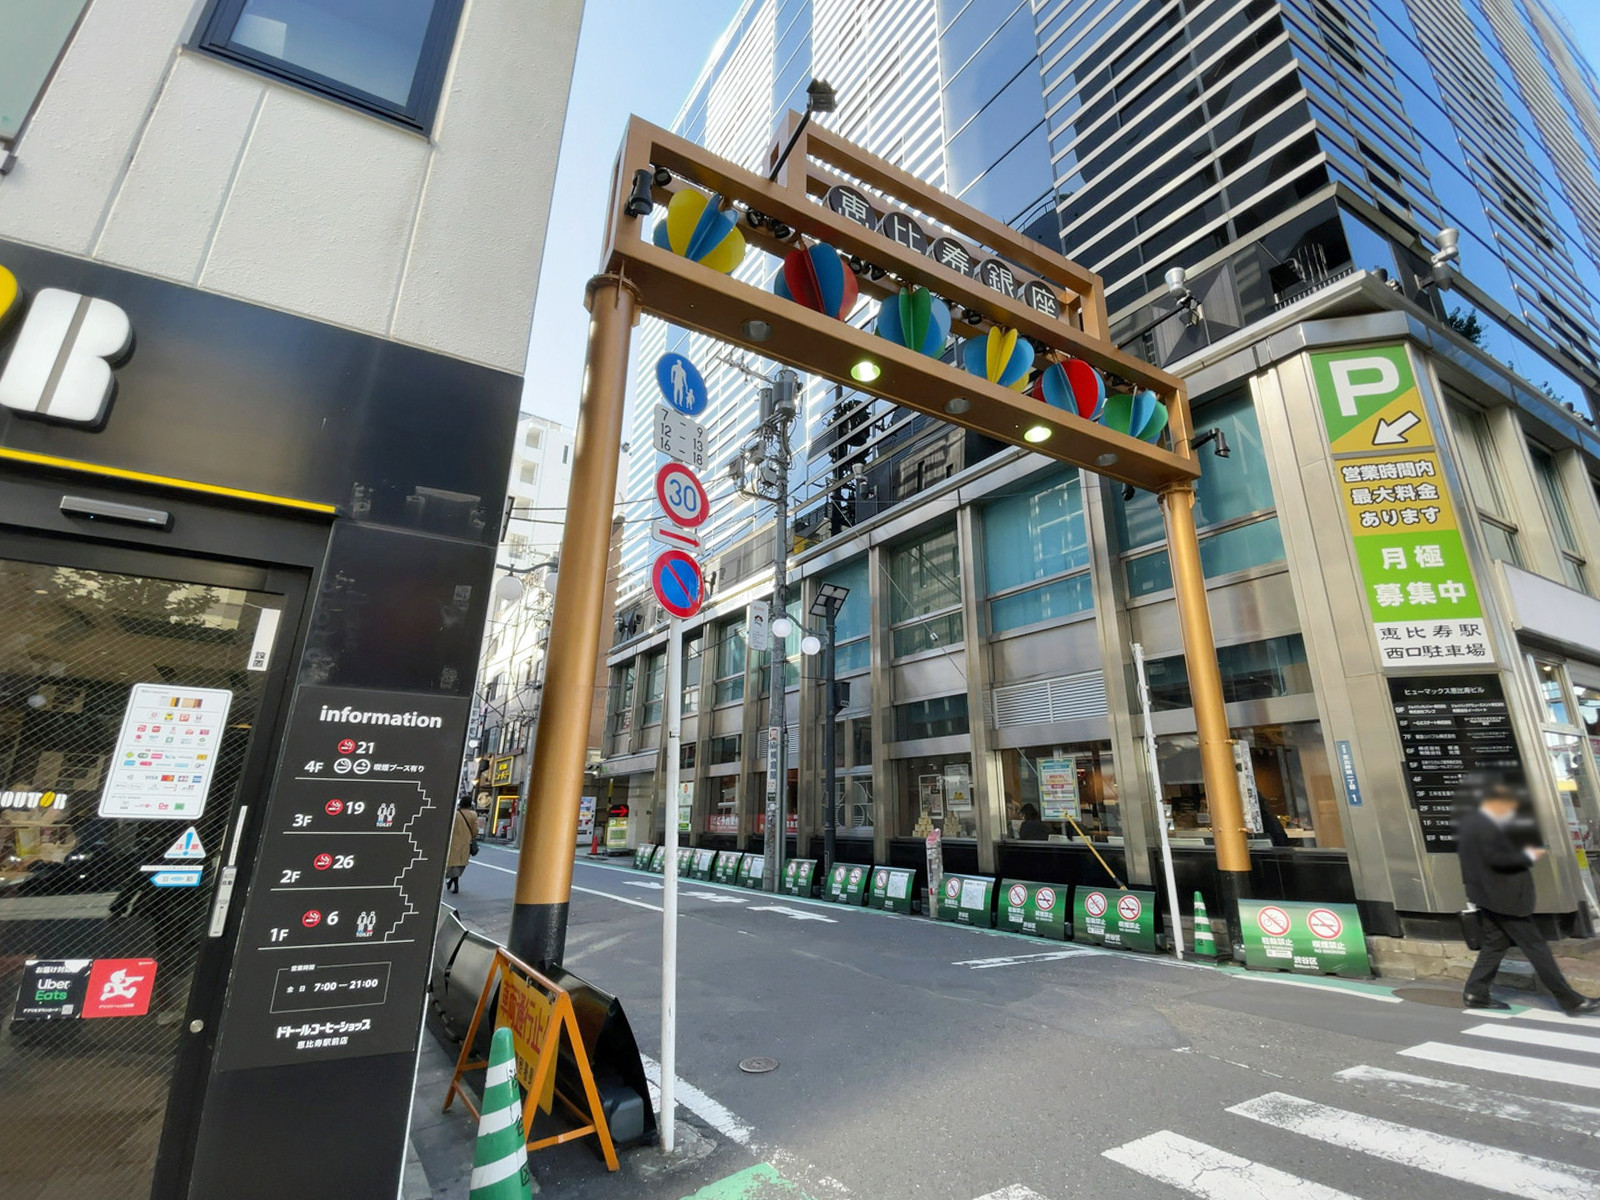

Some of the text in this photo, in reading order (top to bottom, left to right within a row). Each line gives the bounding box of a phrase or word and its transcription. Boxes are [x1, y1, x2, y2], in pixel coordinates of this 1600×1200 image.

[1328, 356, 1399, 416] P
[661, 408, 669, 421] 7
[696, 426, 703, 438] 9
[660, 423, 672, 438] 12
[693, 438, 704, 452] 13
[660, 437, 671, 451] 16
[693, 451, 703, 466] 18
[1341, 459, 1435, 482] 営業時間内
[669, 479, 697, 512] 30
[1351, 483, 1439, 506] 最大料金
[1360, 506, 1440, 528] あります
[1381, 545, 1444, 570] 月極
[1374, 579, 1467, 608] 募集中
[1380, 623, 1482, 640] 恵比寿駅
[1384, 644, 1486, 660] 西口駐車場
[319, 705, 442, 728] information
[356, 741, 375, 754] 21
[304, 760, 425, 773] 4F 喫煙ブース有り
[0, 791, 68, 810] OUTOR
[346, 801, 365, 815] 19
[292, 814, 313, 828] 3F
[333, 855, 355, 869] 26
[280, 870, 301, 883] 2F
[326, 911, 339, 925] 6
[269, 928, 289, 941] 1F
[1312, 940, 1346, 950] 喫煙禁止
[290, 964, 316, 972] 営業時間
[1294, 956, 1318, 965] 渋谷区
[37, 978, 70, 990] Uber
[35, 990, 67, 1001] Eats
[276, 1018, 371, 1039] ドトールコーヒーショップ
[296, 1036, 349, 1050] 恵比寿駅前店
